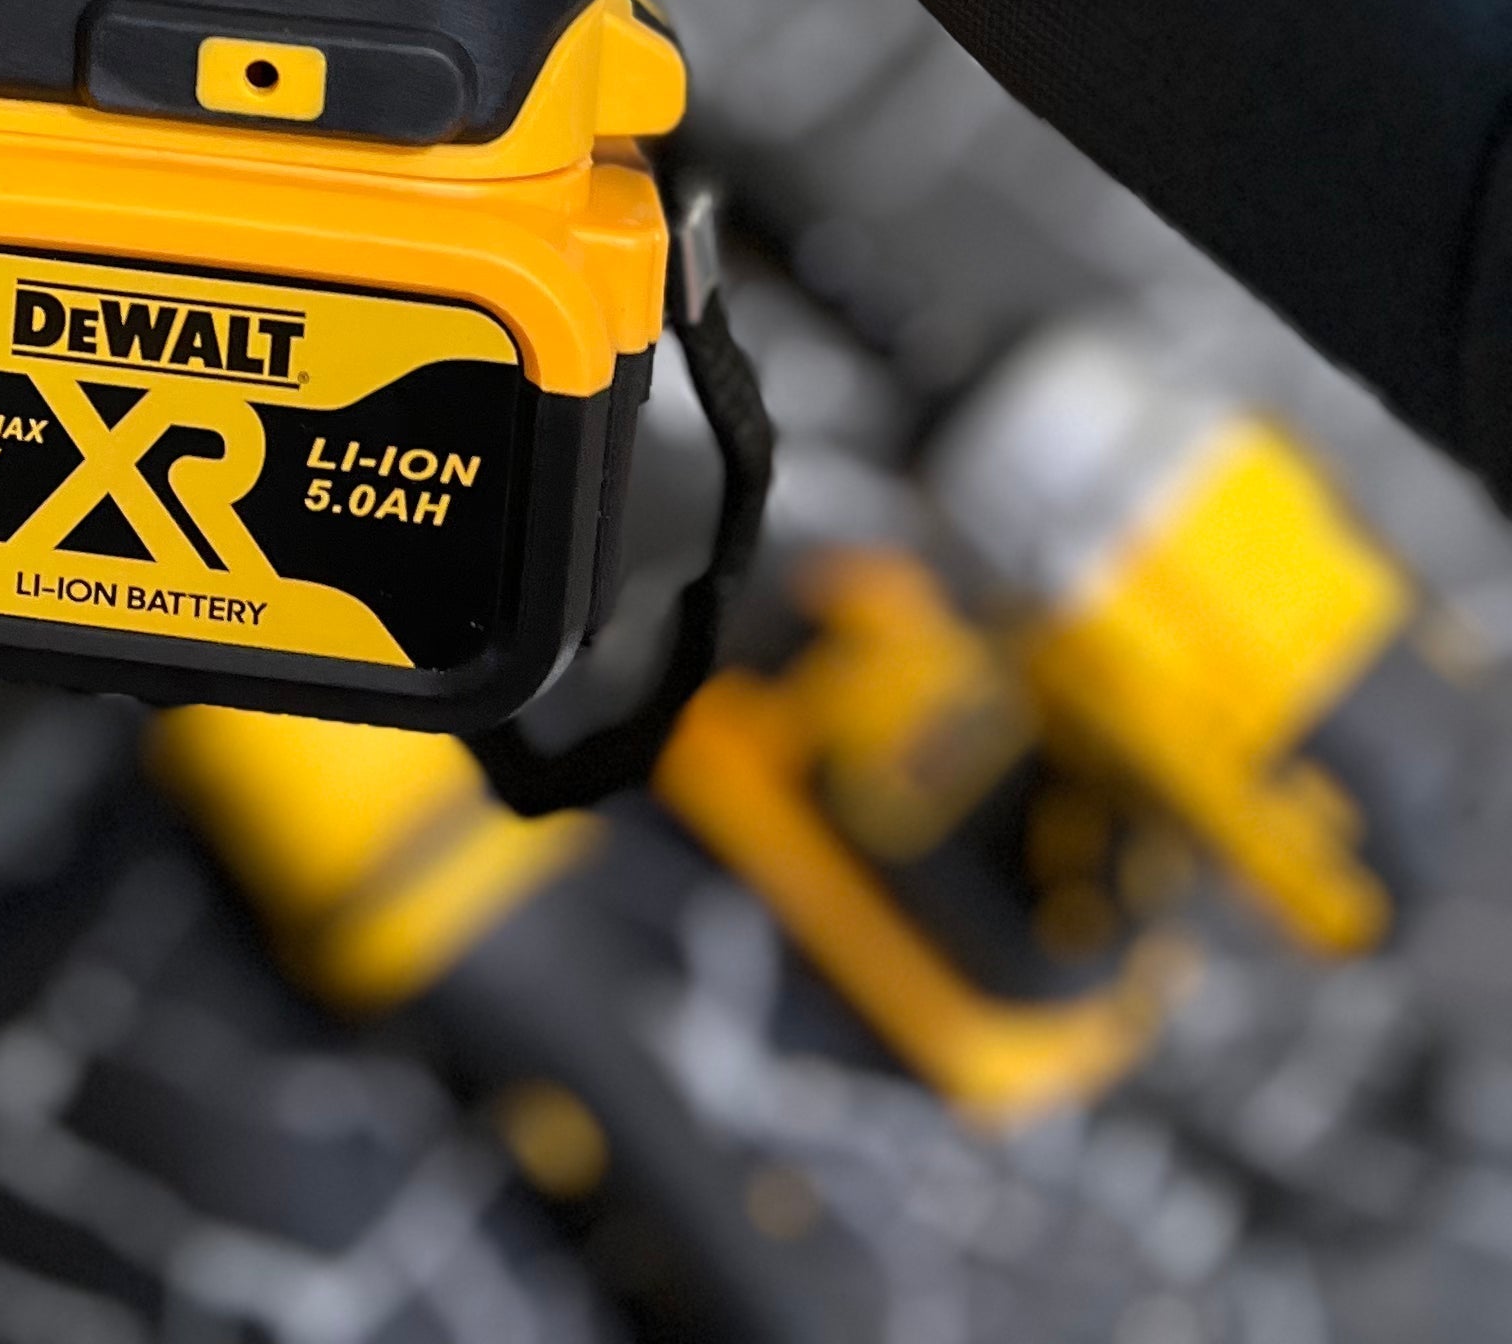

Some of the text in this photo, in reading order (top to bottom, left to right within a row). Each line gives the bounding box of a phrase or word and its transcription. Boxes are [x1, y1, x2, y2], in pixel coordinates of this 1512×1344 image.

[7, 372, 281, 577] XR
[307, 437, 482, 488] LI-ION
[304, 478, 451, 528] 5.0AH
[15, 570, 268, 626] LI-ION BATTERY
